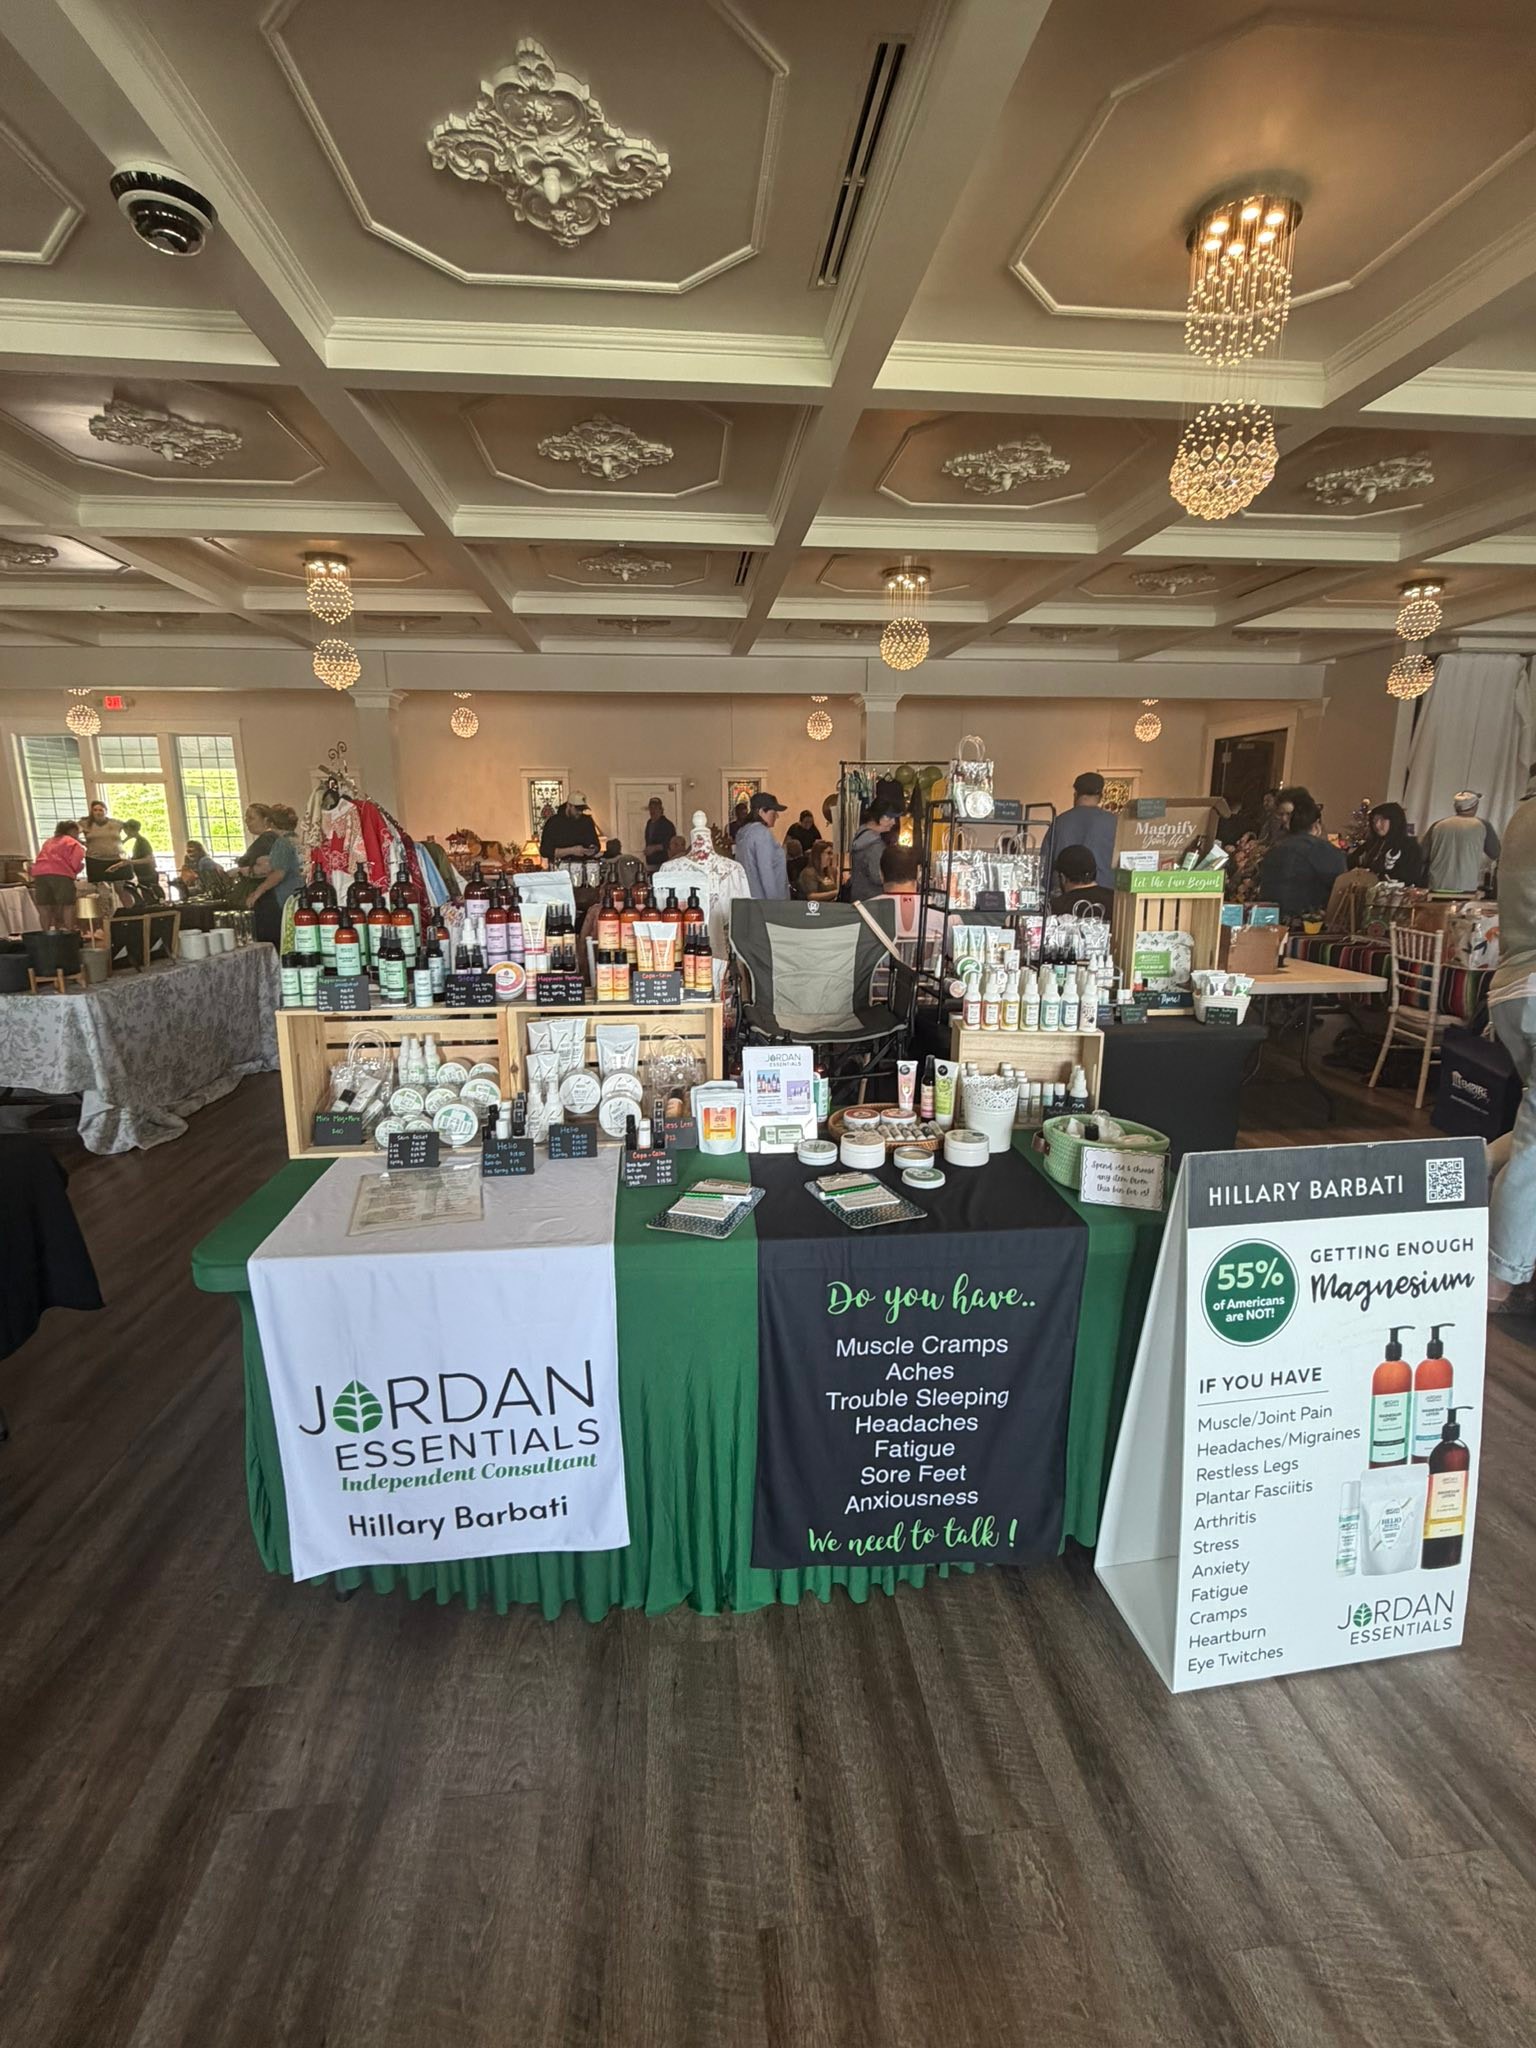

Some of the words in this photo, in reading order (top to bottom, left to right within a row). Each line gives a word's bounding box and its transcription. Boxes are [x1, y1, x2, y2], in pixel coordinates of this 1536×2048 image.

[1135, 821, 1197, 838] Magnify
[1142, 834, 1167, 849] Your
[1168, 834, 1185, 848] life
[765, 1053, 801, 1062] JORDAN
[496, 1142, 517, 1150] Helio
[1209, 1181, 1301, 1206] HILLARY
[1309, 1175, 1403, 1199] BARBATI
[1310, 1243, 1389, 1263] GETTING
[1396, 1238, 1474, 1257] ENOUGH
[1217, 1257, 1284, 1291] 55%
[826, 1280, 876, 1316] Do
[884, 1285, 945, 1325] you
[952, 1273, 1036, 1316] have..
[1213, 1298, 1227, 1311] of
[1227, 1296, 1285, 1310] Americans
[1311, 1270, 1475, 1312] Magnesium
[1225, 1311, 1245, 1323] are
[1246, 1307, 1275, 1320] NOT!
[836, 1336, 915, 1358] Muscle
[922, 1335, 1009, 1358] Cramps
[885, 1362, 955, 1382] Aches
[1200, 1378, 1217, 1394] IF
[1222, 1373, 1263, 1391] YOU
[1270, 1367, 1322, 1386] HAVE
[298, 1359, 595, 1436] JORDAN
[826, 1388, 909, 1411] Trouble
[915, 1387, 1010, 1410] Sleeping
[855, 1414, 979, 1435] Headaches
[1198, 1409, 1296, 1433] Muscle/Joint
[1300, 1405, 1333, 1422] Pain
[335, 1418, 600, 1471] ESSENTIALS
[875, 1439, 956, 1462] Fatigue
[1197, 1426, 1361, 1457] Headaches/Migraines
[341, 1466, 477, 1493] Independent
[481, 1453, 598, 1480] Consultant
[860, 1466, 911, 1486] Sore
[918, 1464, 967, 1483] Feet
[1196, 1463, 1259, 1482] Restless
[1264, 1457, 1299, 1475] Legs
[844, 1489, 979, 1515] Anxiousness
[1196, 1489, 1251, 1507] Plantar
[1254, 1480, 1314, 1499] Fasciitis
[349, 1512, 445, 1541] Hillary
[455, 1495, 568, 1530] Barbati
[1193, 1511, 1257, 1531] Arthritis
[807, 1528, 842, 1554] We
[848, 1521, 907, 1557] need
[910, 1519, 940, 1550] to
[943, 1515, 1000, 1548] talk
[1193, 1537, 1240, 1555] Stress
[1191, 1559, 1250, 1579] Anxiety
[1191, 1583, 1249, 1603] Fatigue
[1189, 1606, 1248, 1626] Cramps
[1337, 1590, 1455, 1630] JORDAN
[1189, 1626, 1266, 1649] Heartburn
[1350, 1617, 1453, 1645] ESSENTIALS
[1187, 1657, 1215, 1674] Eye
[1218, 1647, 1284, 1667] Twitches
